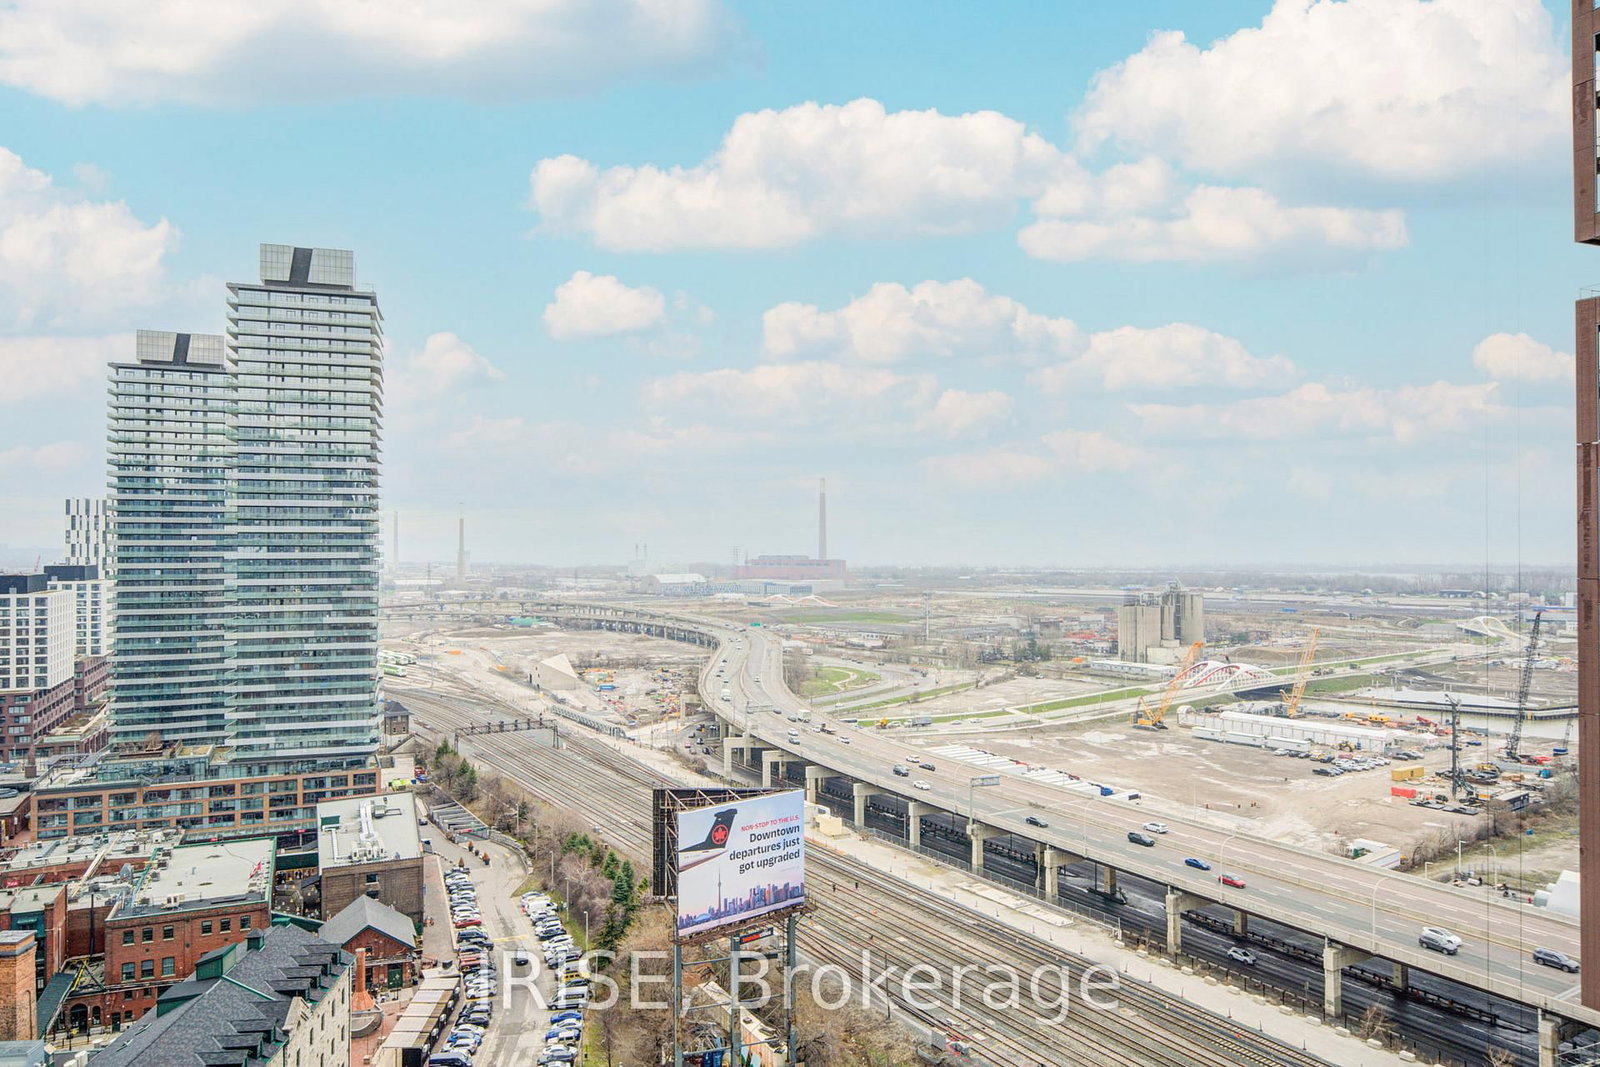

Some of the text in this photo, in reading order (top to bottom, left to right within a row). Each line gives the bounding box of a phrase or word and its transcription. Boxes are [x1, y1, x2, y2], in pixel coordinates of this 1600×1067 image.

[741, 821, 769, 831] NON-STOP
[749, 825, 800, 843] Downtown
[729, 837, 800, 861] departures just
[739, 849, 800, 874] got upgraded
